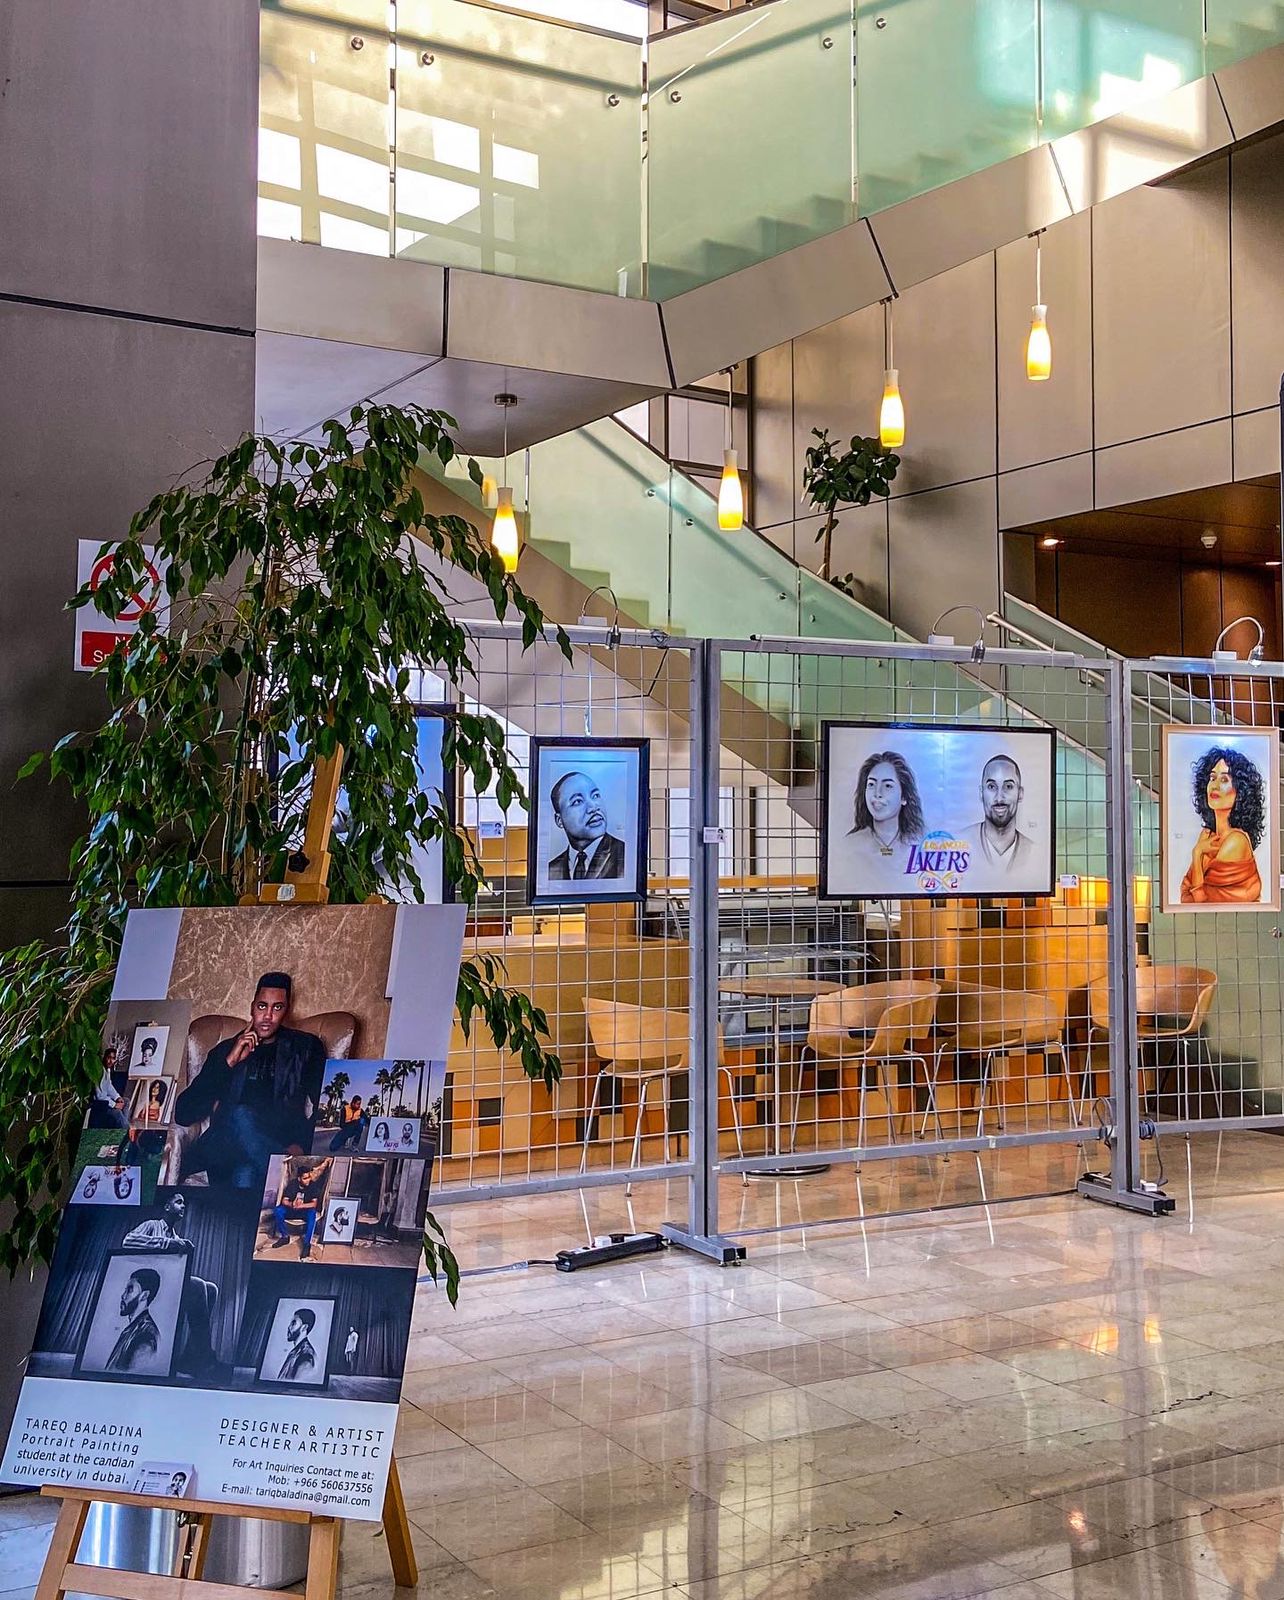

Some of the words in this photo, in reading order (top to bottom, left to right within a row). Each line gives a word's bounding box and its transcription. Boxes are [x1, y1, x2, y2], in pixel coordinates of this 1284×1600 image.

[903, 844, 970, 874] LAKERS
[925, 877, 936, 888] 24
[26, 1417, 68, 1433] TAREQ
[74, 1422, 143, 1438] BALADINA
[220, 1418, 299, 1435] DESIGNER
[308, 1425, 317, 1437] &
[325, 1427, 385, 1442] ARTIST
[21, 1433, 75, 1448] Portrait
[81, 1438, 139, 1455] Painting
[219, 1433, 292, 1451] TEACHER
[17, 1448, 57, 1462] student
[58, 1453, 71, 1463] at
[73, 1453, 91, 1465] the
[93, 1456, 135, 1468] candian
[13, 1464, 72, 1481] university
[76, 1469, 87, 1480] in
[92, 1470, 129, 1484] dubai.
[232, 1458, 247, 1468] For
[249, 1460, 263, 1470] Art
[265, 1461, 304, 1474] Inquiries
[306, 1465, 342, 1477] Contact
[344, 1470, 359, 1479] me
[361, 1471, 375, 1480] at:
[267, 1474, 290, 1485] Mob:
[294, 1477, 318, 1488] +966
[320, 1479, 373, 1494] 560637556
[221, 1483, 252, 1495] E-mail:
[255, 1486, 371, 1507] tariqbaladina@gmail.com
